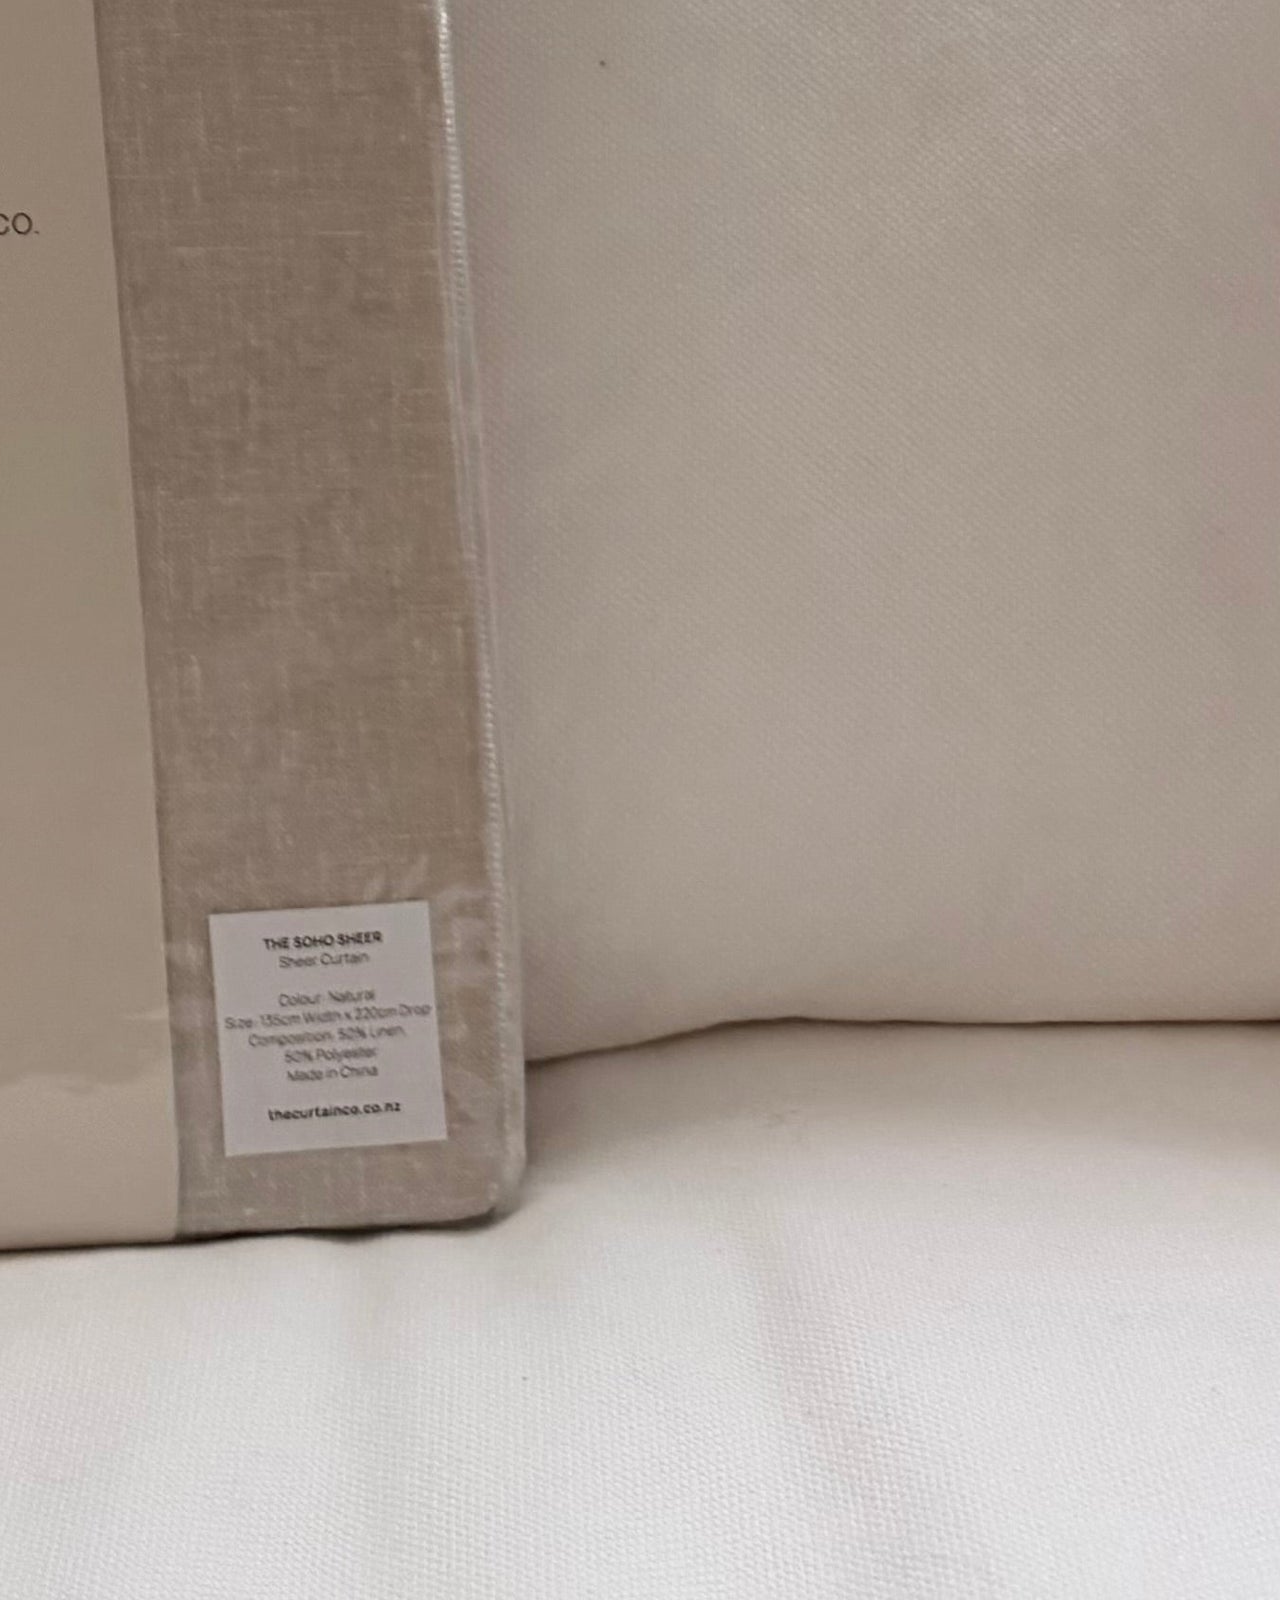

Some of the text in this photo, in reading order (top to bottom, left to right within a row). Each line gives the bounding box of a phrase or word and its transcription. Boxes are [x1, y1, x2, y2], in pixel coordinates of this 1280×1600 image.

[263, 930, 383, 951] THE SOHO SHEER
[279, 951, 370, 969] Sheer Curtain
[287, 1065, 379, 1082] Made in China
[267, 1101, 402, 1121] thecurtainco.co.nz
